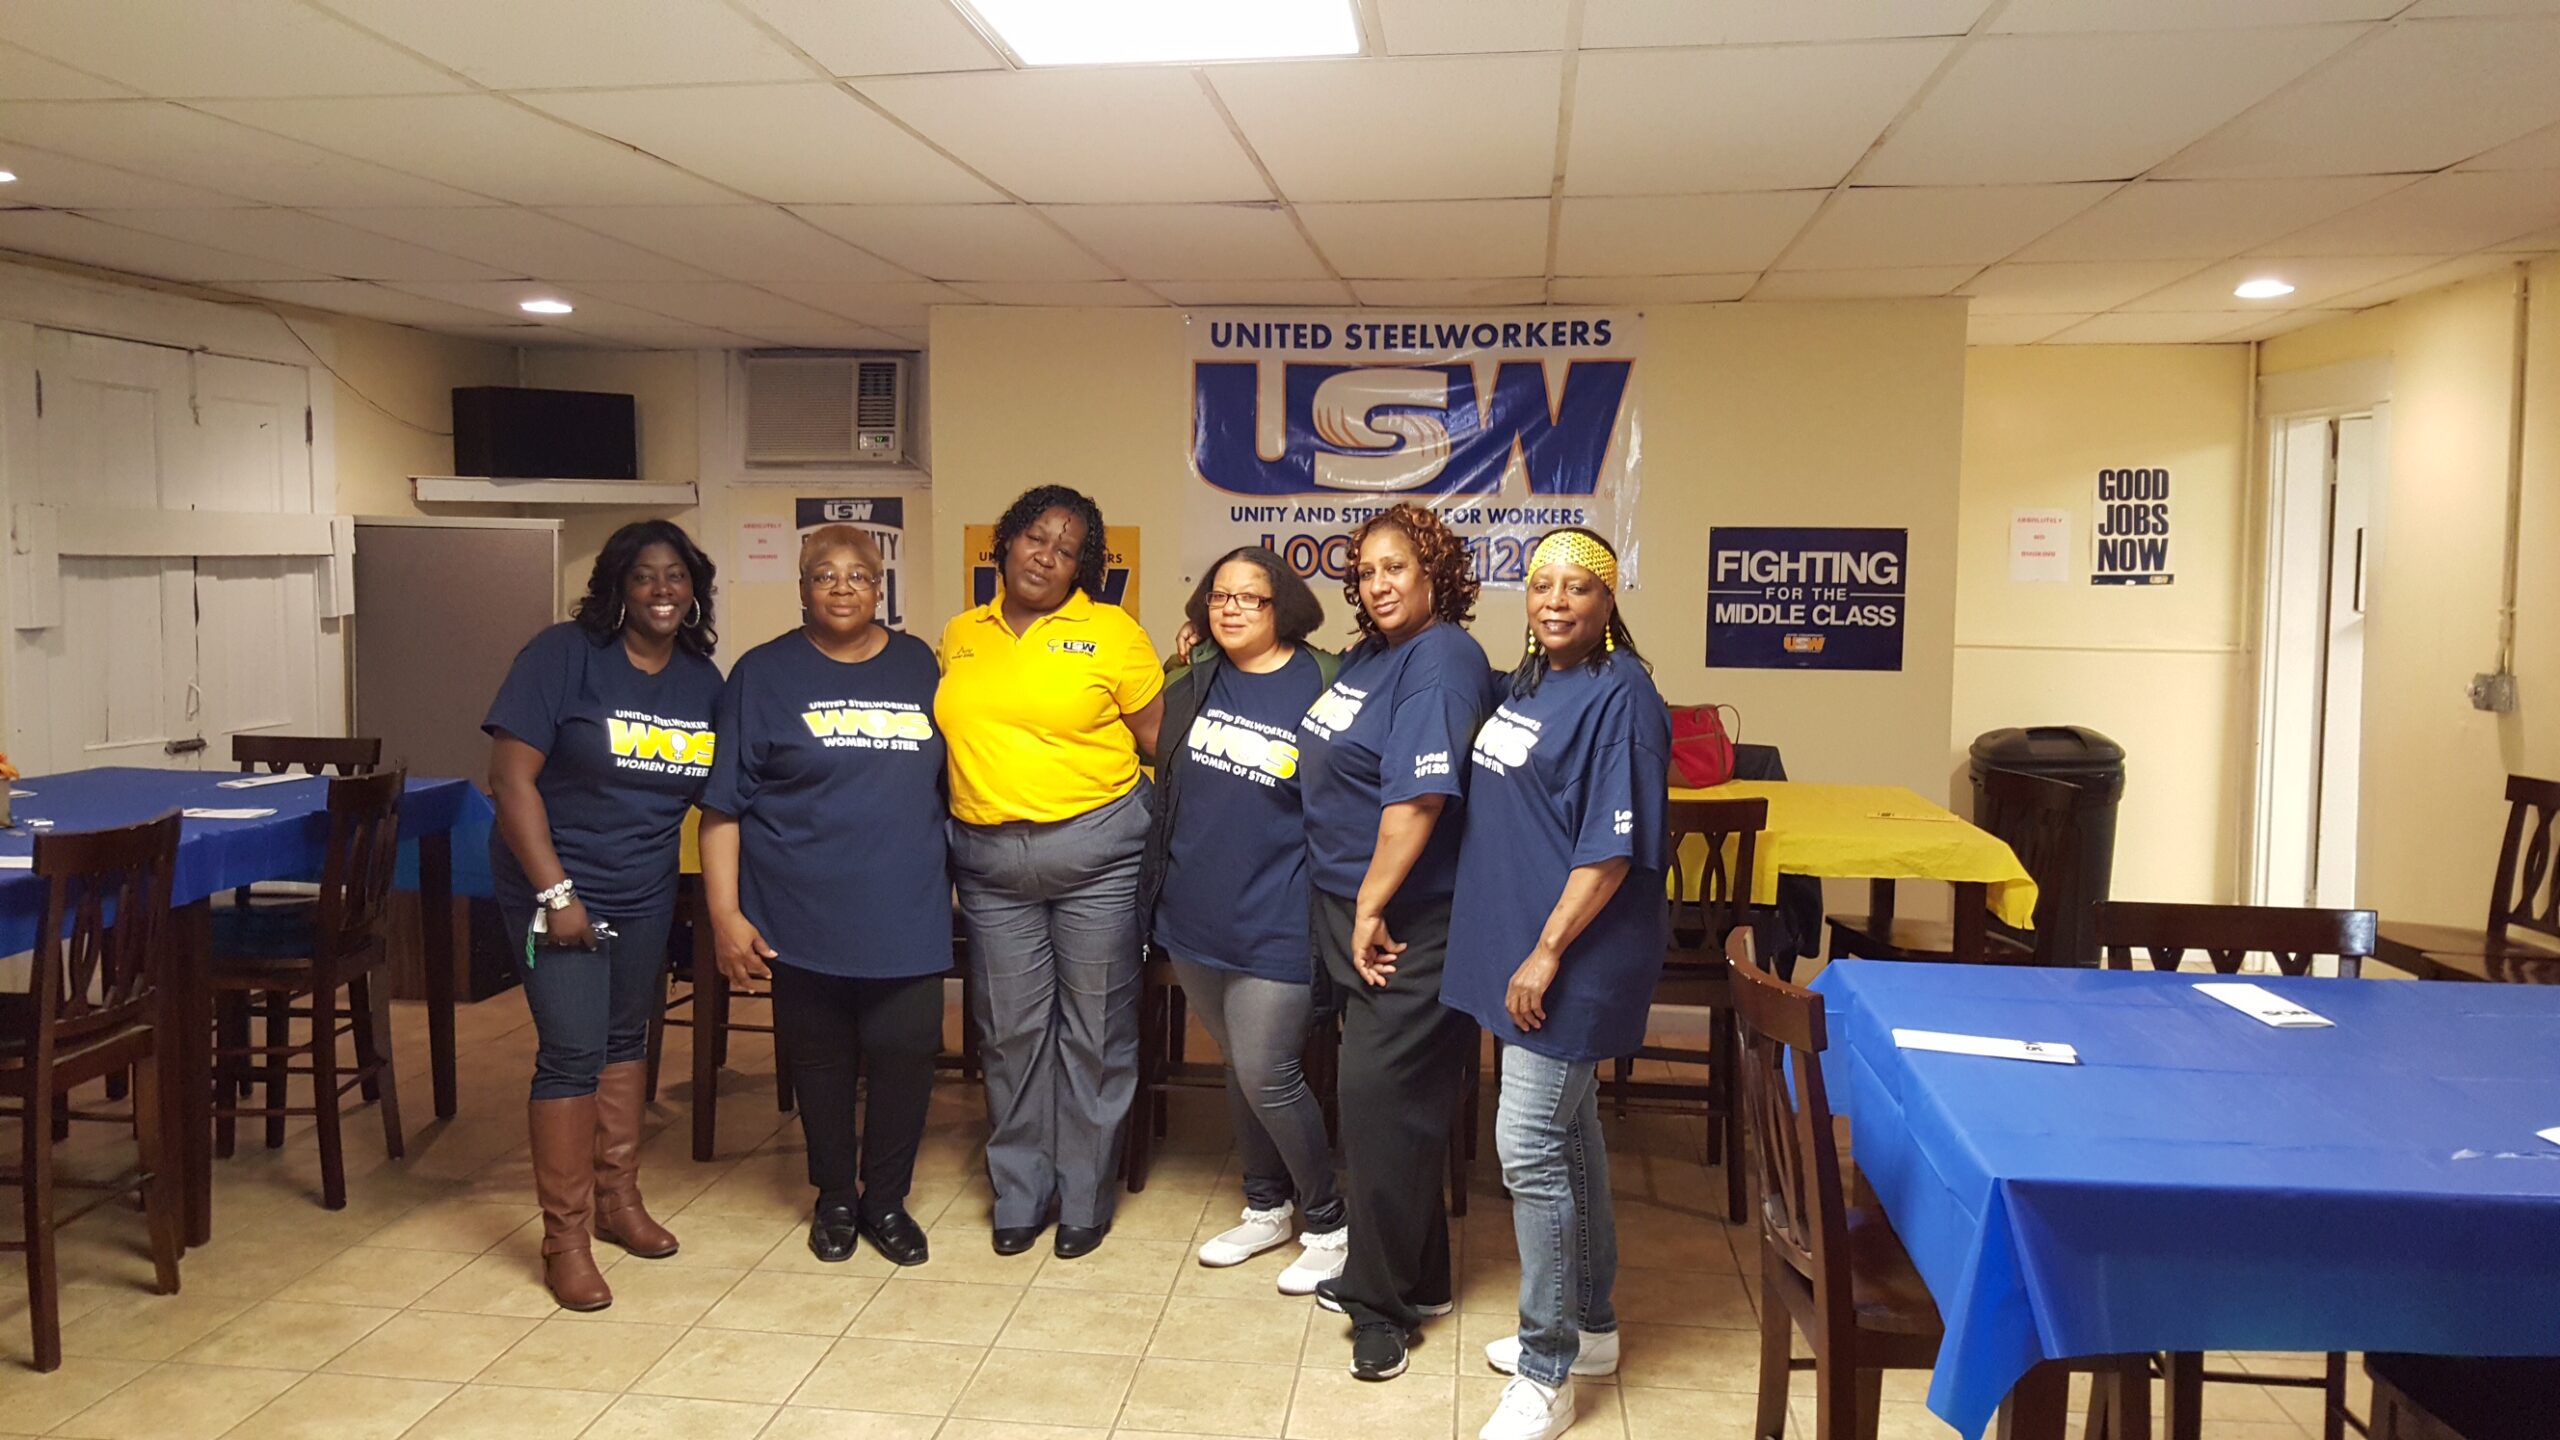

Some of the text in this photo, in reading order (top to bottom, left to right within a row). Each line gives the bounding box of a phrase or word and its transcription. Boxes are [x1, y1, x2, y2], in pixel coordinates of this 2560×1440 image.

[1211, 319, 1612, 350] UNITED STEELWORKERS
[1192, 358, 1636, 498] USW
[2099, 468, 2169, 501] GOOD
[824, 504, 873, 521] USW
[1231, 506, 1289, 523] UNITY
[1293, 506, 1335, 523] AND
[1445, 507, 1482, 525] FOR
[1487, 507, 1585, 526] WORKERS
[2098, 503, 2169, 536] JOBS
[1716, 550, 1899, 586] FIGHTING
[2098, 538, 2169, 572] NOW
[1765, 586, 1847, 601] FOR THE
[1715, 603, 1897, 627] MIDDLE CLASS
[615, 709, 653, 722] UNITED
[807, 699, 921, 711] UNITED STEELWORKERS
[801, 708, 933, 741] WOS
[1206, 708, 1235, 723] UNITED
[1234, 715, 1298, 744] STEELWORKERS
[606, 717, 716, 767] WOS
[823, 737, 920, 751] WOMEN OF STEEL
[1187, 715, 1300, 780] WOS
[616, 757, 666, 773] WOMEN
[667, 763, 684, 775] OF
[1190, 749, 1277, 788] WOMEN OF STEEL
